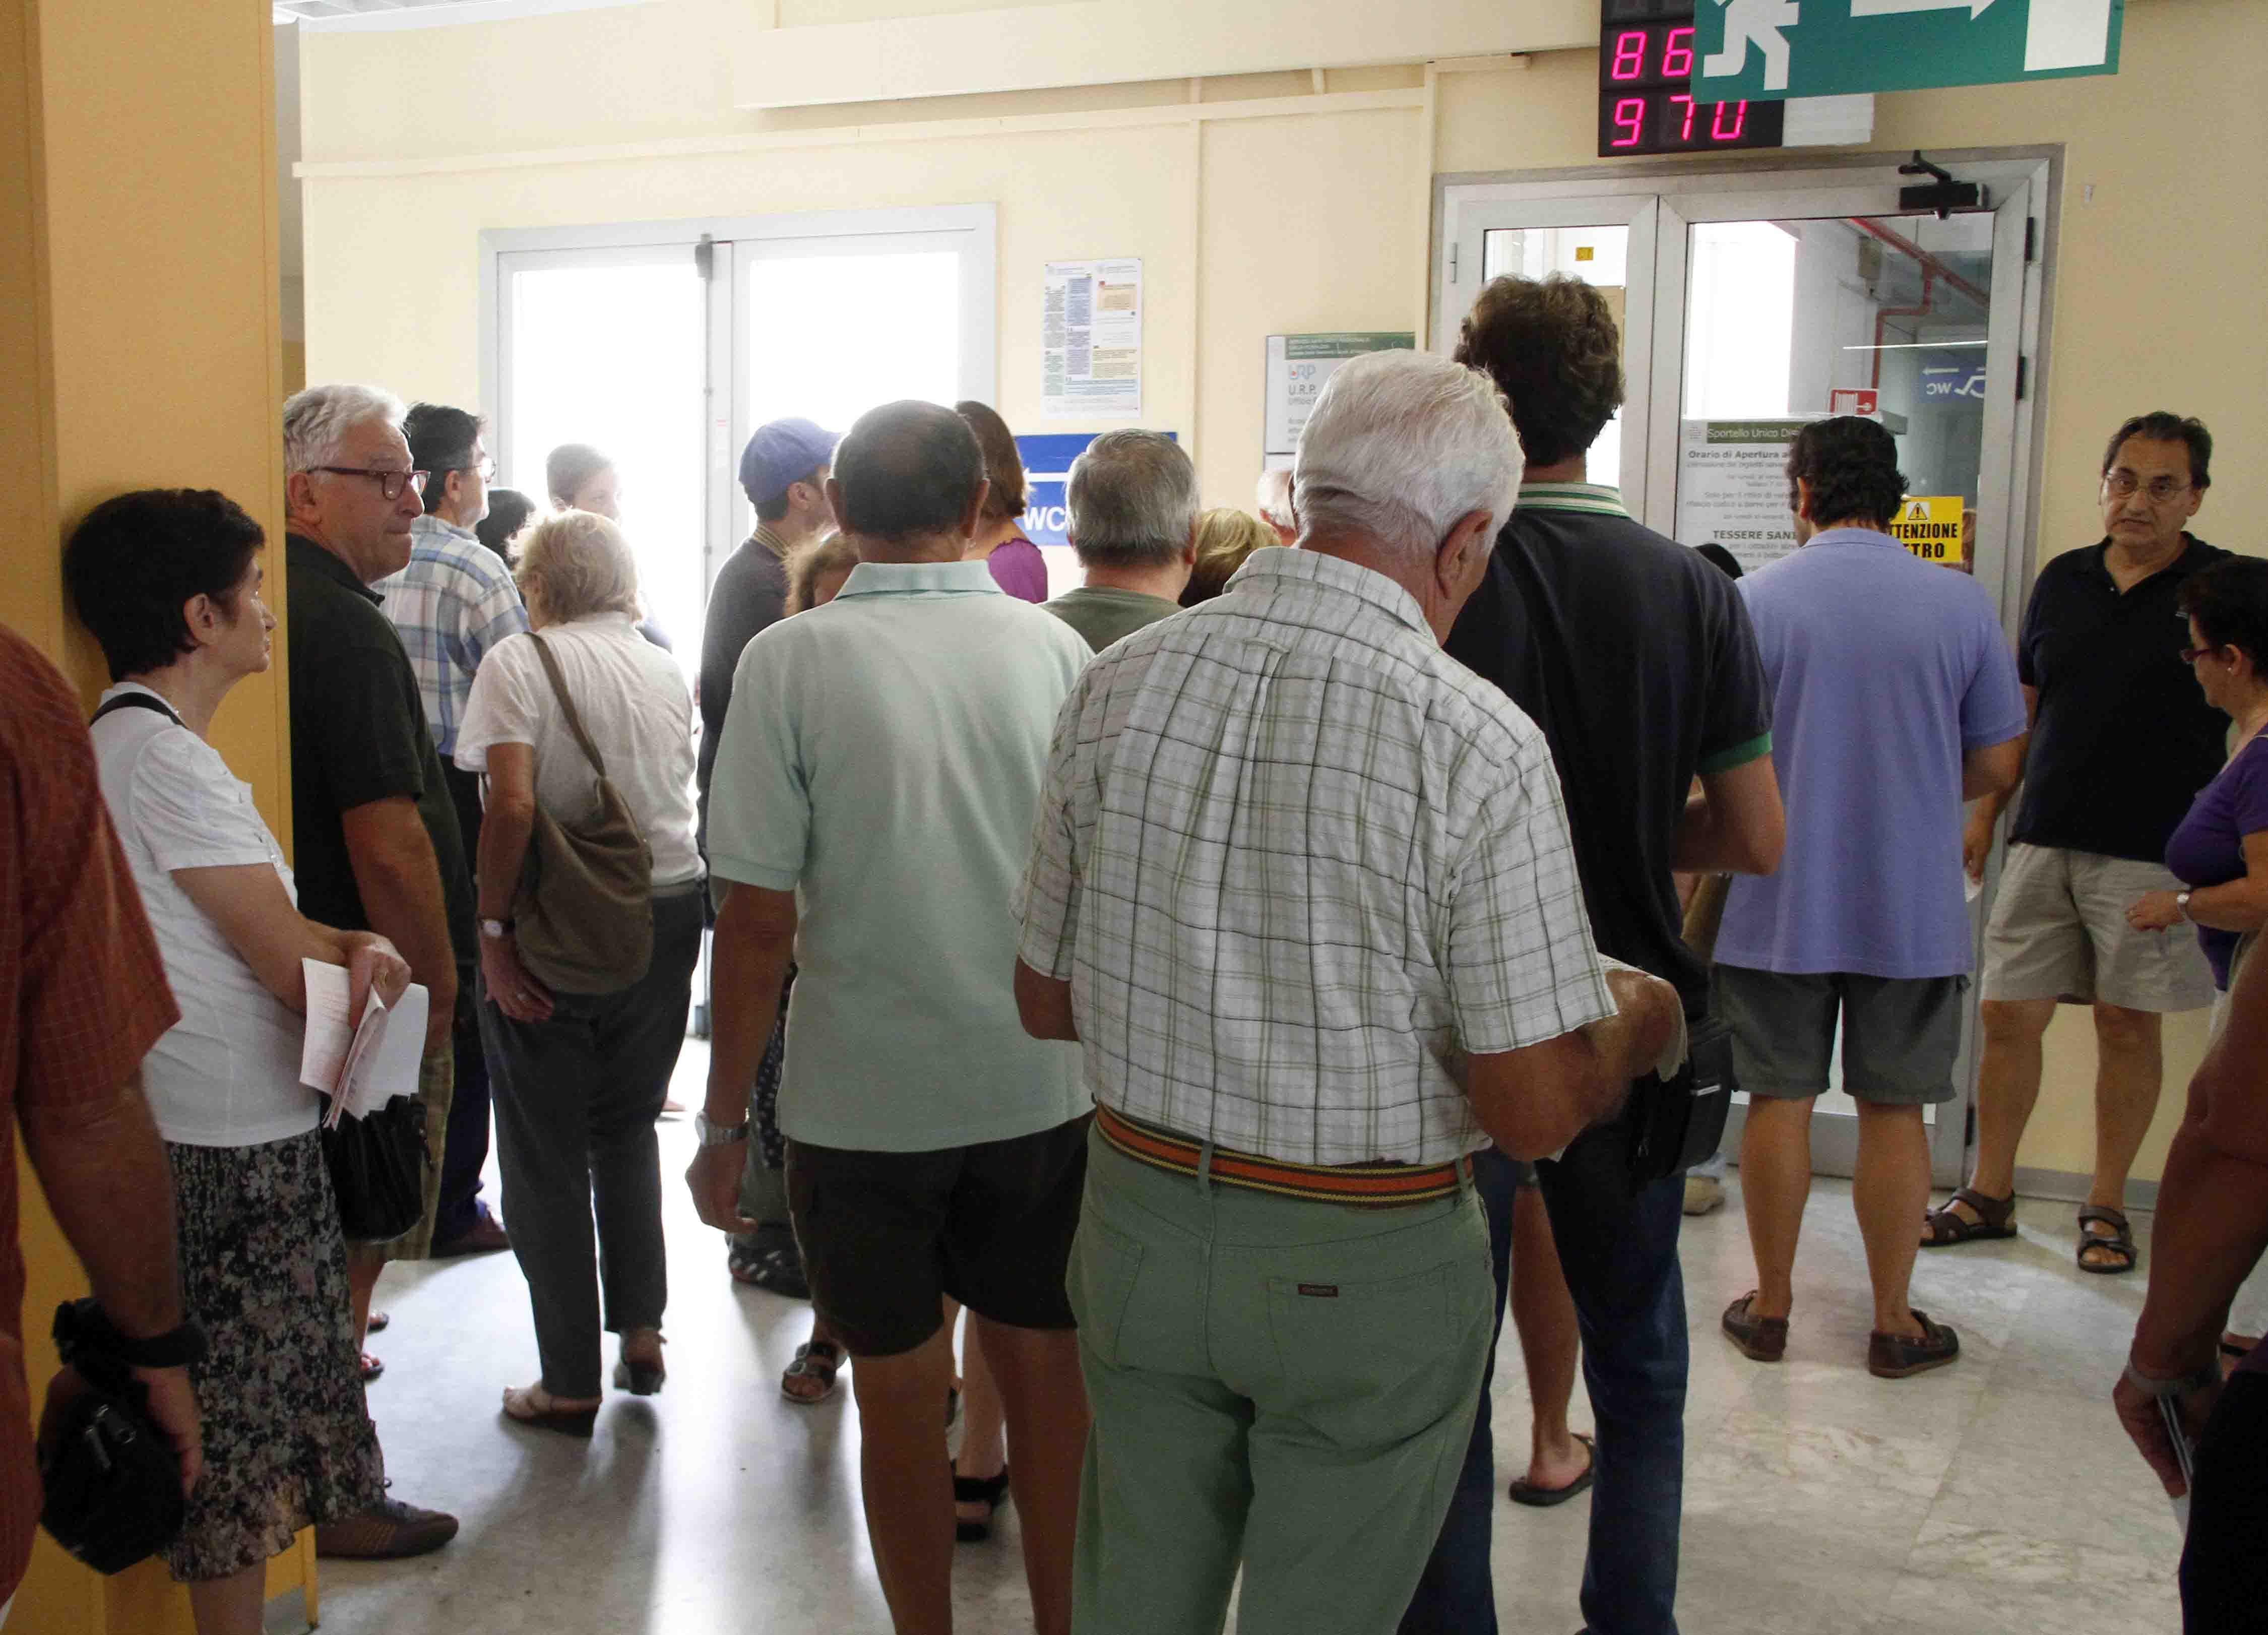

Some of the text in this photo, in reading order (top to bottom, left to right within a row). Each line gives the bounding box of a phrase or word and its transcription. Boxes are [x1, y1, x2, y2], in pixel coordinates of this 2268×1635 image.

[1708, 429, 1749, 439] Sportello
[1751, 429, 1778, 437] Unico
[1688, 450, 1720, 459] Orario
[1722, 450, 1731, 458] di
[1734, 450, 1779, 460] Apertura
[1024, 507, 1065, 531] WC
[1713, 530, 1762, 540] TESSERE
[1888, 523, 1958, 539] TTENZIONE
[1903, 543, 1945, 558] TRO
